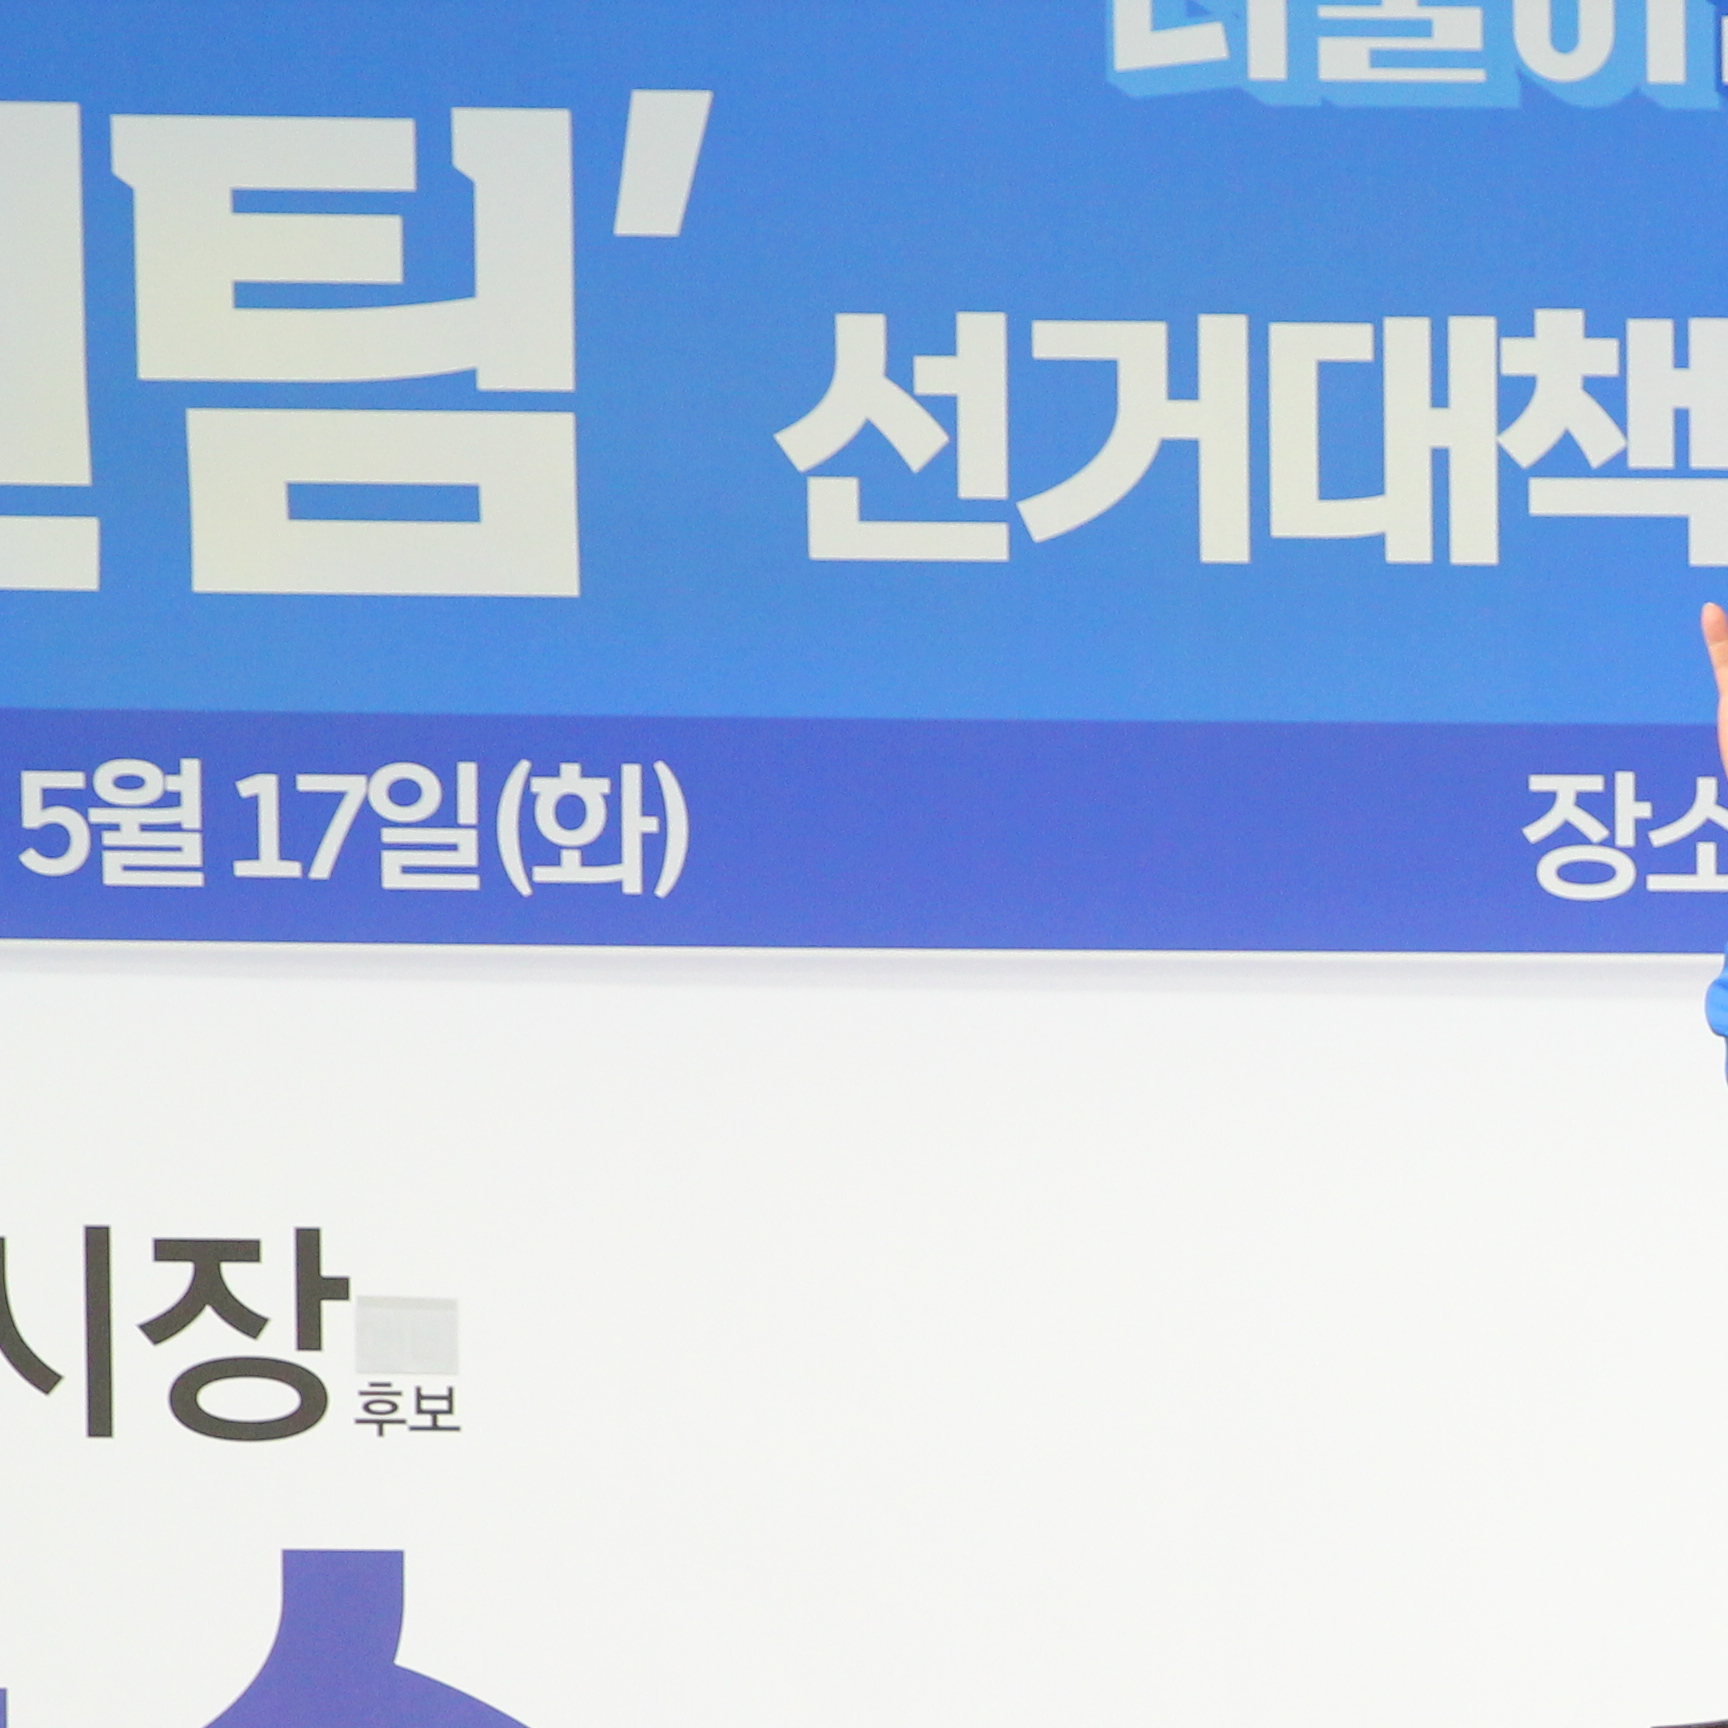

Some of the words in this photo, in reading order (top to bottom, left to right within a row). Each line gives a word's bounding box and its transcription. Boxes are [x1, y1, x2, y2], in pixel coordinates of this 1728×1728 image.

[0, 90, 712, 597] 팀'
[19, 759, 205, 888] 5월
[233, 760, 690, 898] 17일(화)
[354, 1382, 461, 1437] 후보
